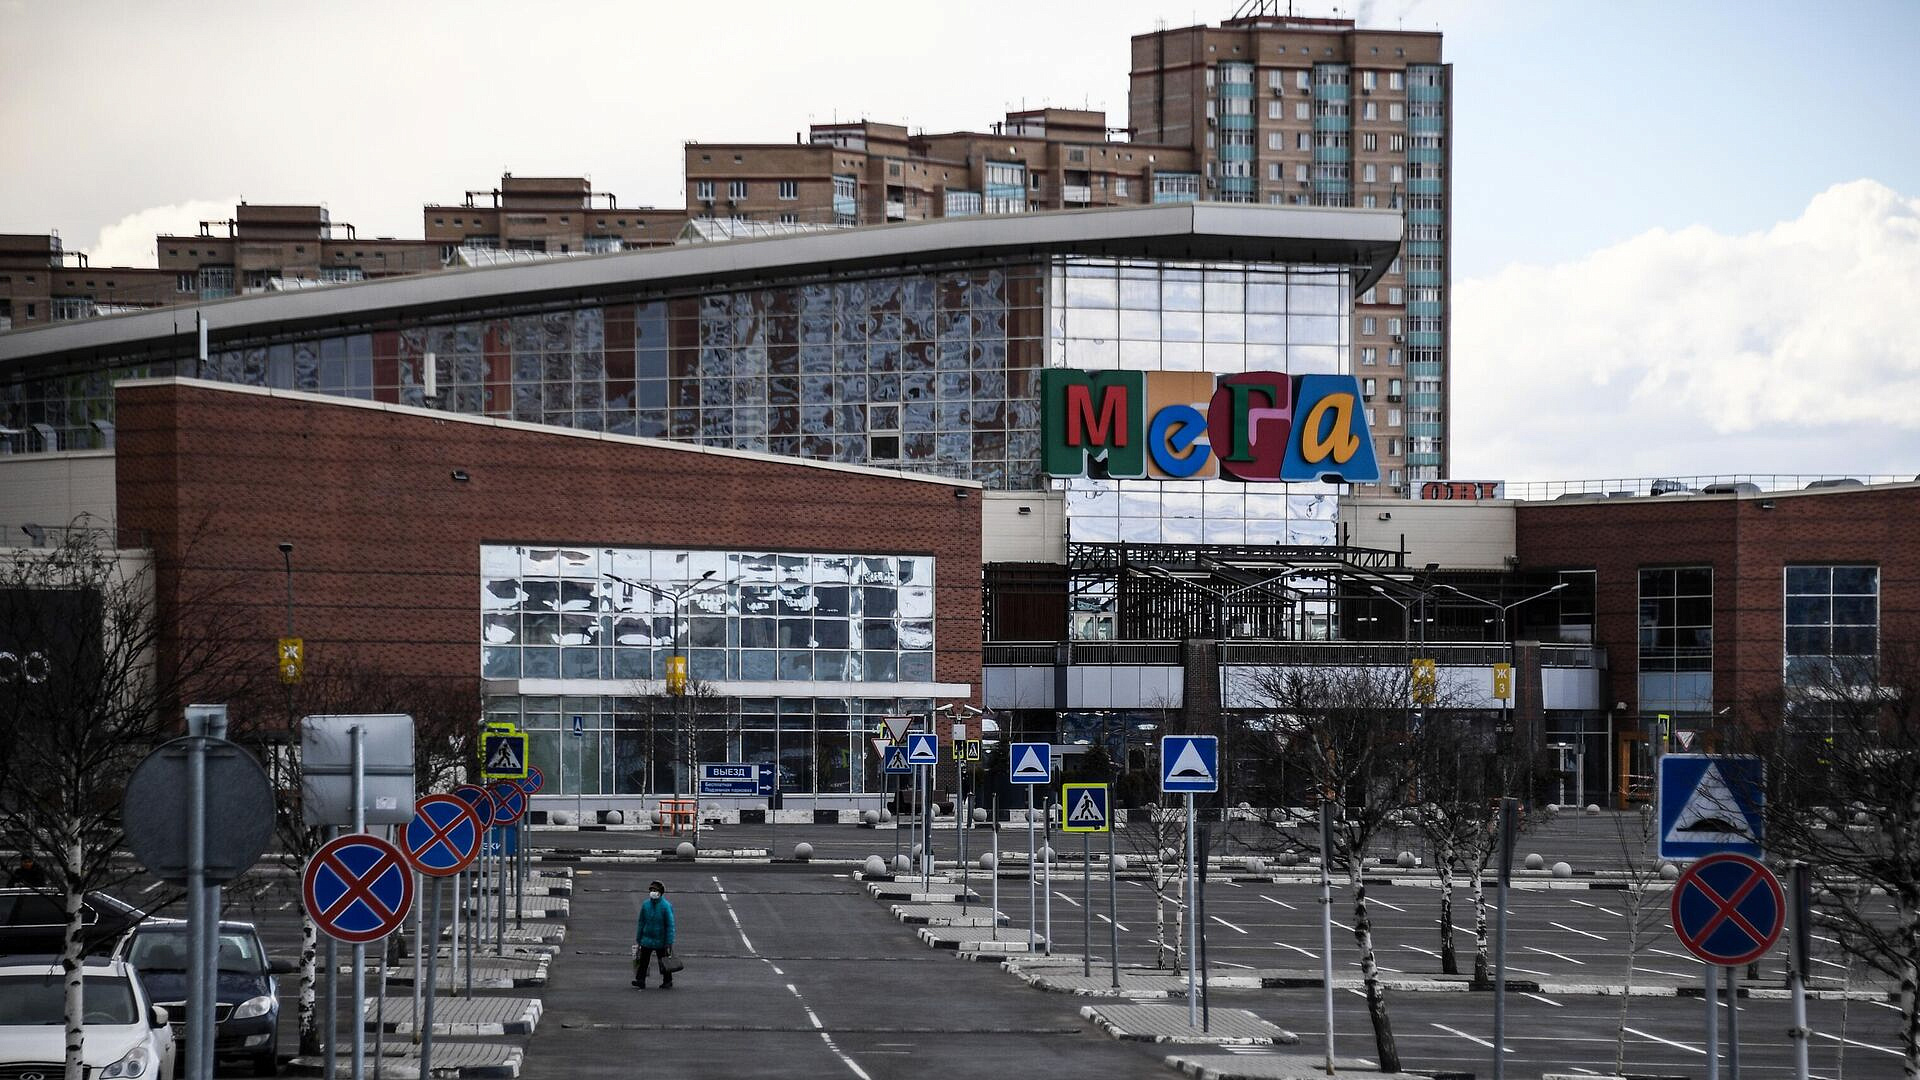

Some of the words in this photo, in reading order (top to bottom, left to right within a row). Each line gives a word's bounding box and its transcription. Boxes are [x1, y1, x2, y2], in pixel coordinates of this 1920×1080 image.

[1421, 482, 1498, 500] OBI
[1496, 668, 1507, 679] Ж
[1499, 682, 1505, 693] 3
[713, 768, 745, 777] ВЫЕЗД
